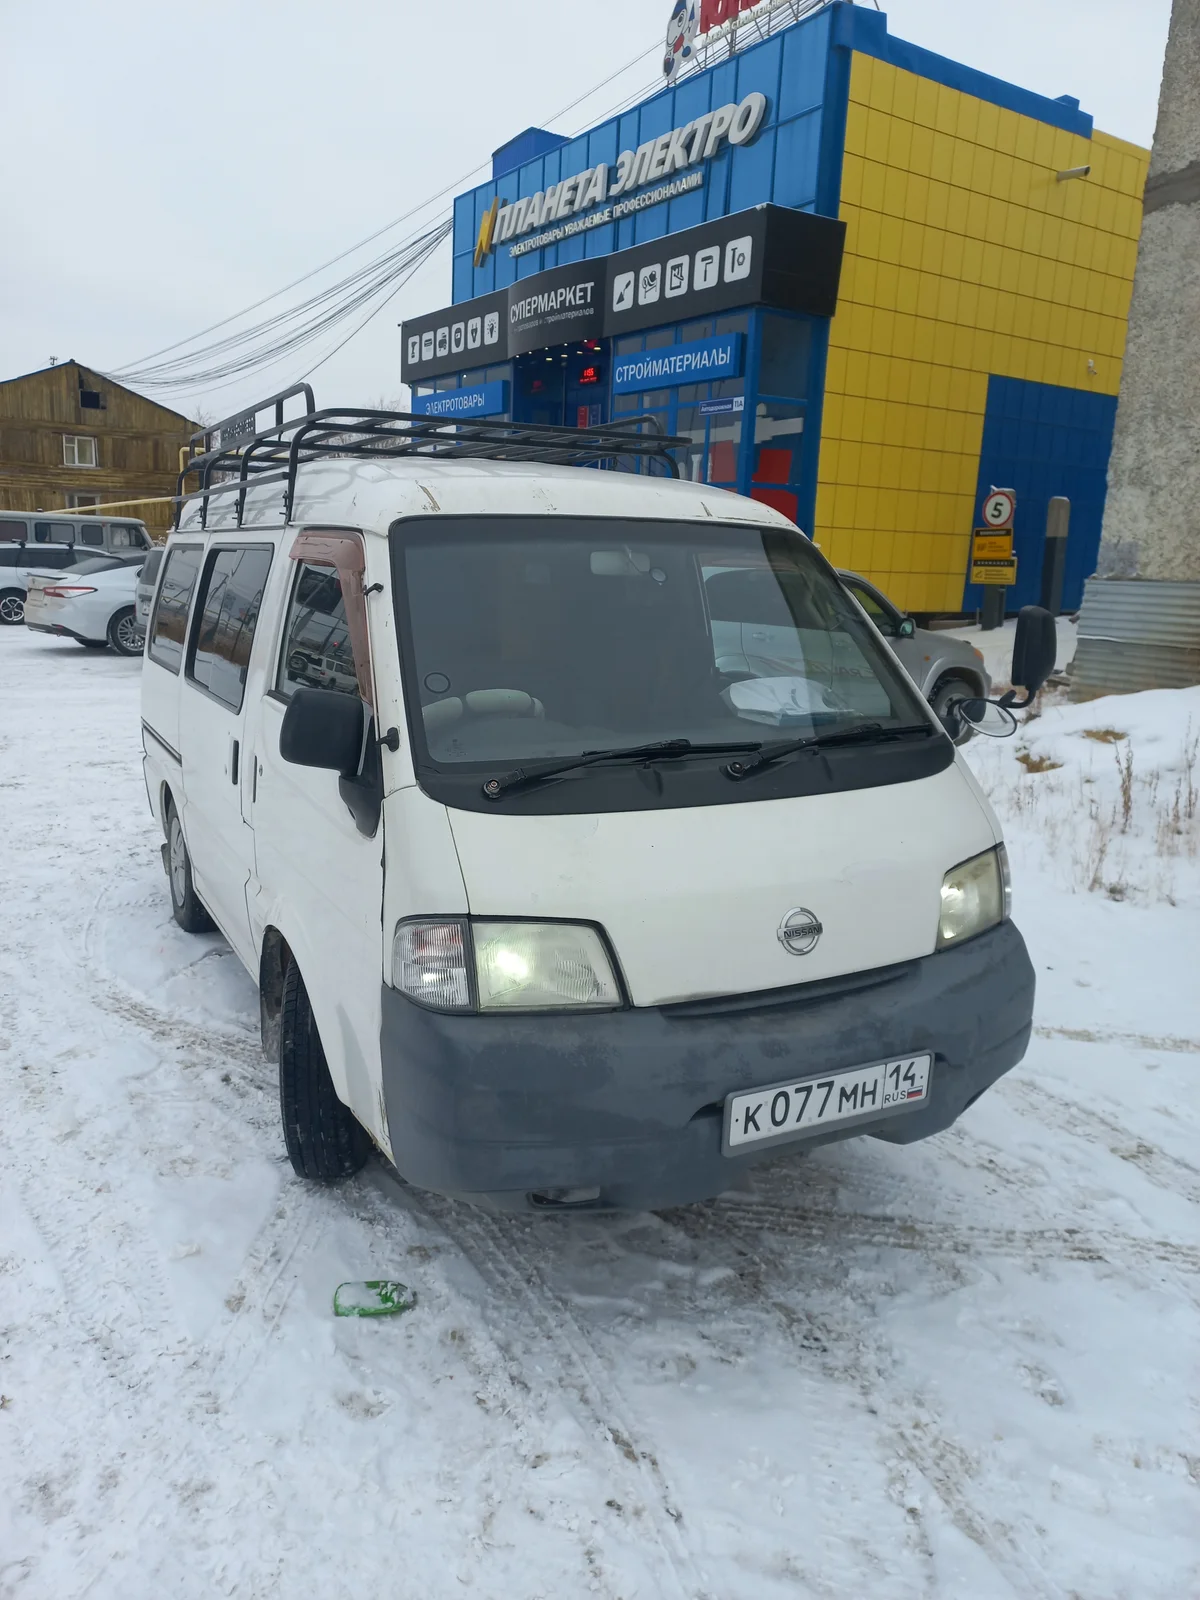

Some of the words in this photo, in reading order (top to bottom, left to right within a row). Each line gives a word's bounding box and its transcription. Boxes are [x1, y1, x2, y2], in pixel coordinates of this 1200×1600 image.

[492, 163, 608, 245] ПЛАНЕТА
[608, 92, 767, 197] ЭЛЕКТРО
[508, 228, 564, 258] ЭЛЕКТРОТОВАРЫ
[564, 208, 612, 236] УВАЖАЕМЫЕ
[612, 171, 703, 219] ПРОФЕССИОНАЛАМИ
[510, 281, 595, 324] СУПЕРМАРКЕТ
[615, 346, 731, 383] СТРОЙМАТЕРИАЛЫ
[425, 392, 485, 415] ЭЛЕКТРОТОВАРЫ
[991, 502, 1004, 519] 5
[783, 926, 820, 938] NISSAN
[743, 1078, 878, 1135] К077МН
[889, 1061, 916, 1091] 14
[884, 1089, 907, 1105] RUS
